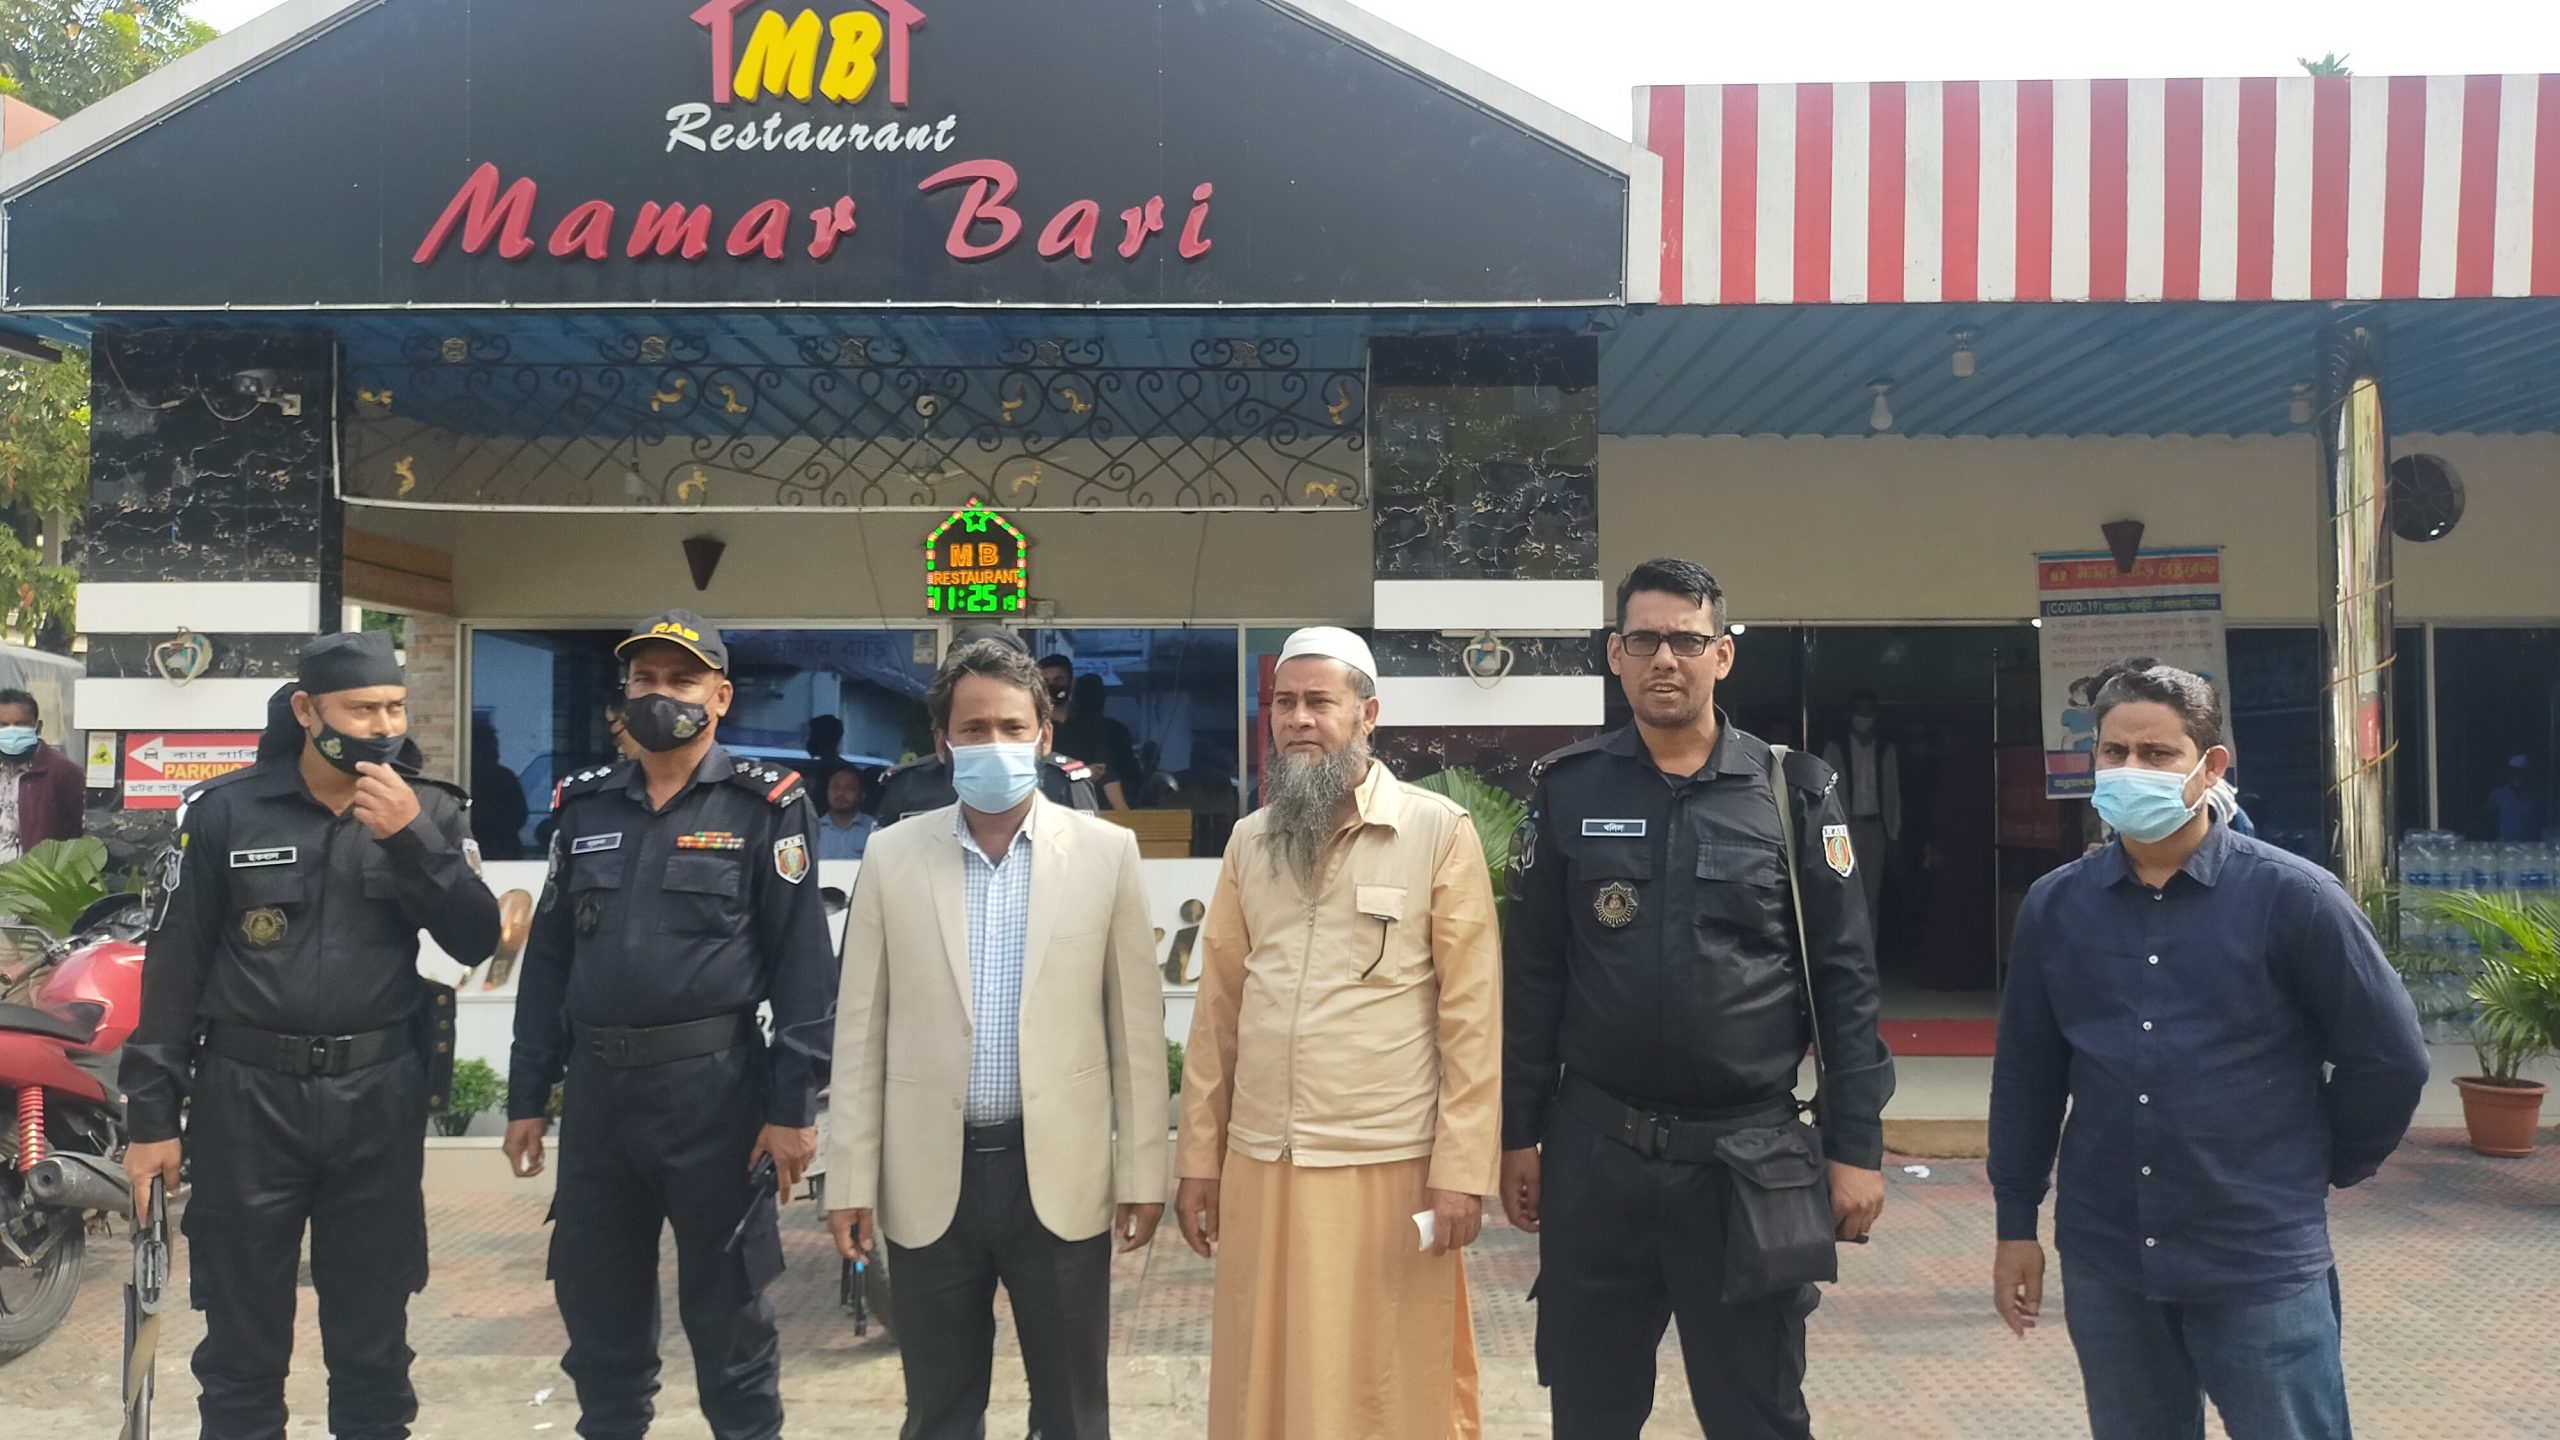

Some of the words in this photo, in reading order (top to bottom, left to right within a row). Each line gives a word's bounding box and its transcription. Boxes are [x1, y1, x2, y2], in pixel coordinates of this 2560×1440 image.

[733, 7, 884, 104] MB
[665, 102, 957, 154] Restaurant
[412, 161, 857, 264] Mamar
[918, 159, 1216, 261] Bari
[933, 569, 1019, 585] RESTAURANT
[651, 621, 700, 641] RAB
